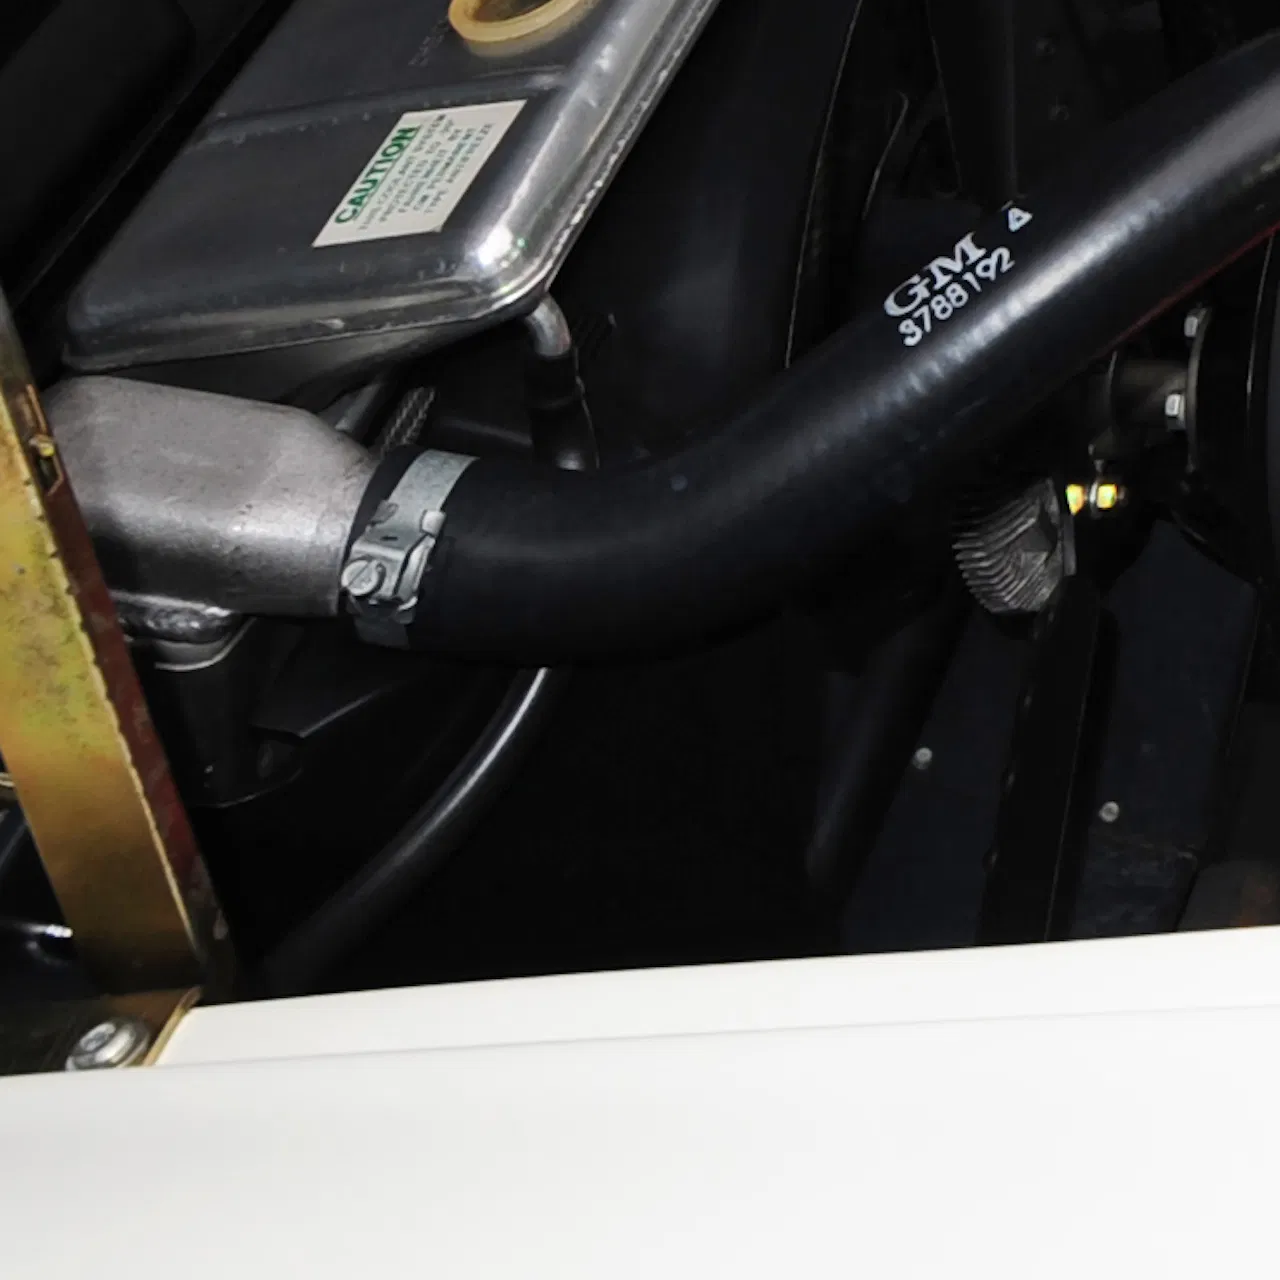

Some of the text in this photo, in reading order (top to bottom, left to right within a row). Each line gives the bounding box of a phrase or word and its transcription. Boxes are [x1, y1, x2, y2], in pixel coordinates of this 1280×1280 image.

[334, 126, 419, 224] CAUTION
[883, 232, 987, 317] GM
[898, 247, 1015, 347] 3788192
